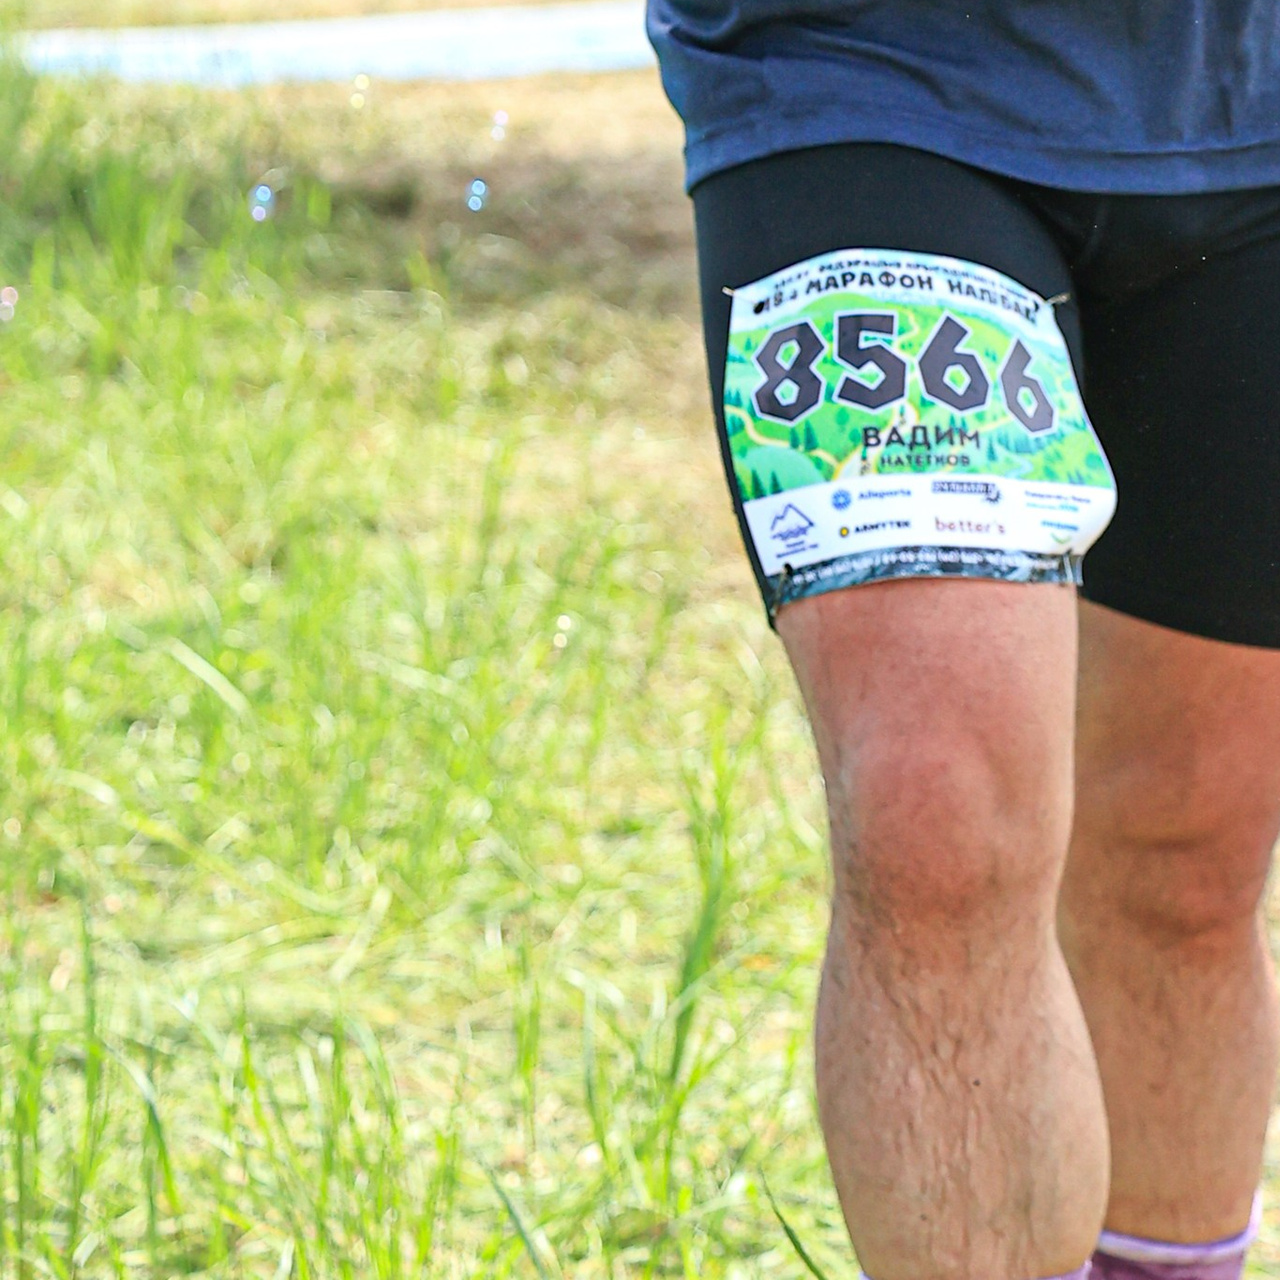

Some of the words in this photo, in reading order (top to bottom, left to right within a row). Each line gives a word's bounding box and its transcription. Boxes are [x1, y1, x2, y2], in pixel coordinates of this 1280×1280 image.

[806, 271, 933, 295] МАРАФОН
[754, 312, 1057, 435] 8566
[862, 425, 980, 451] ВАДИМ
